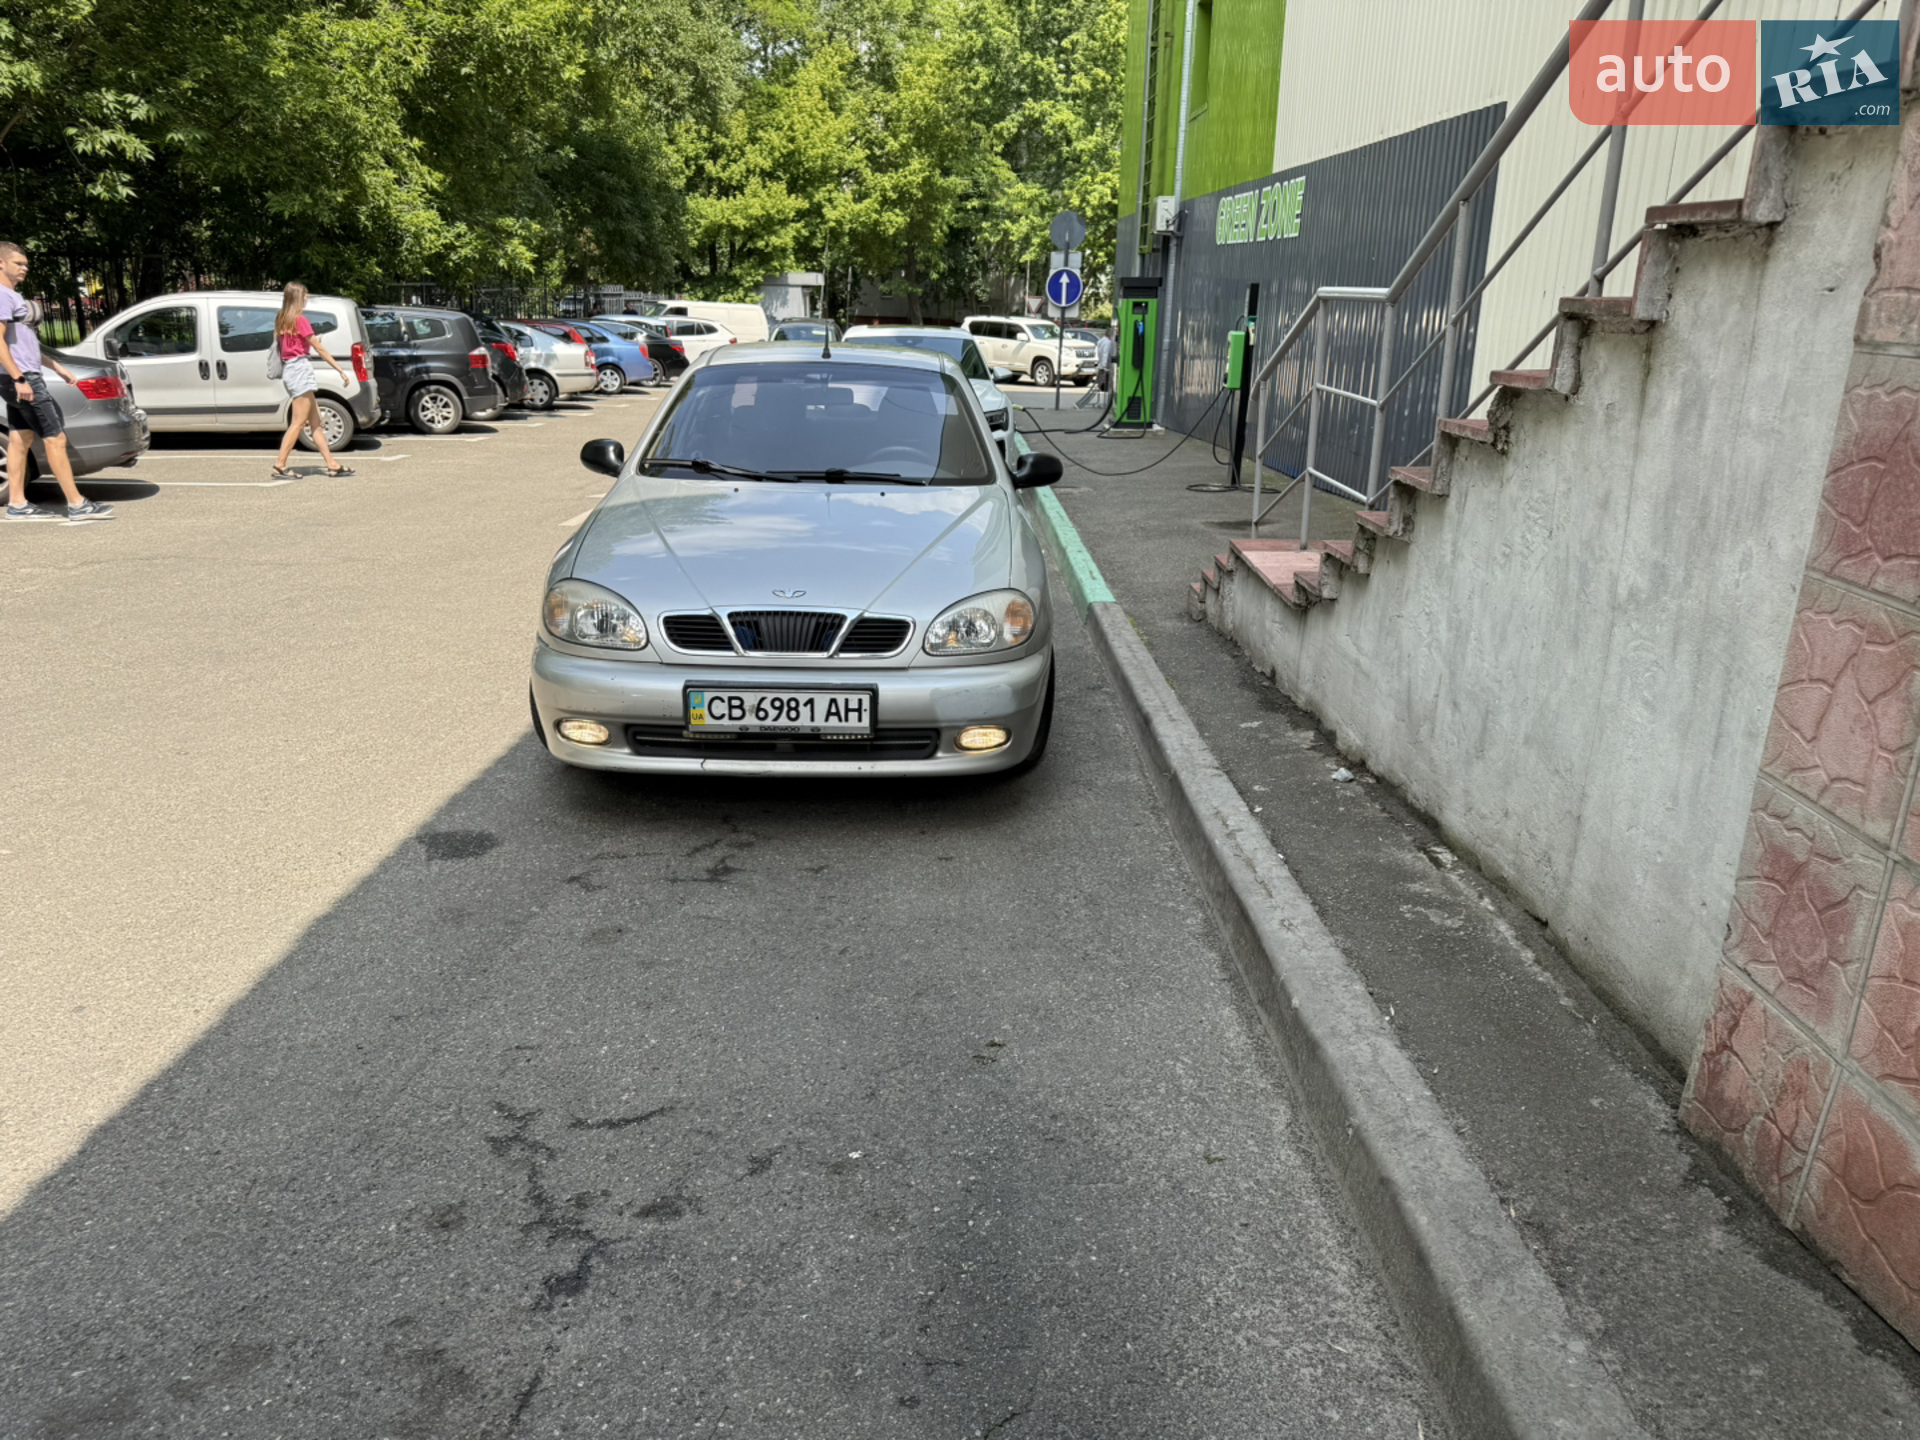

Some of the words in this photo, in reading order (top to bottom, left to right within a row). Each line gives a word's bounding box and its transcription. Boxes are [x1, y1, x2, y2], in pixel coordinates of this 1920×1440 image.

[1216, 189, 1259, 245] GREEN
[1256, 175, 1306, 241] ZONE
[691, 712, 705, 721] UA
[707, 695, 746, 721] CB
[755, 696, 815, 722] 6981
[824, 697, 863, 723] AH
[759, 725, 801, 733] DAEWOO
